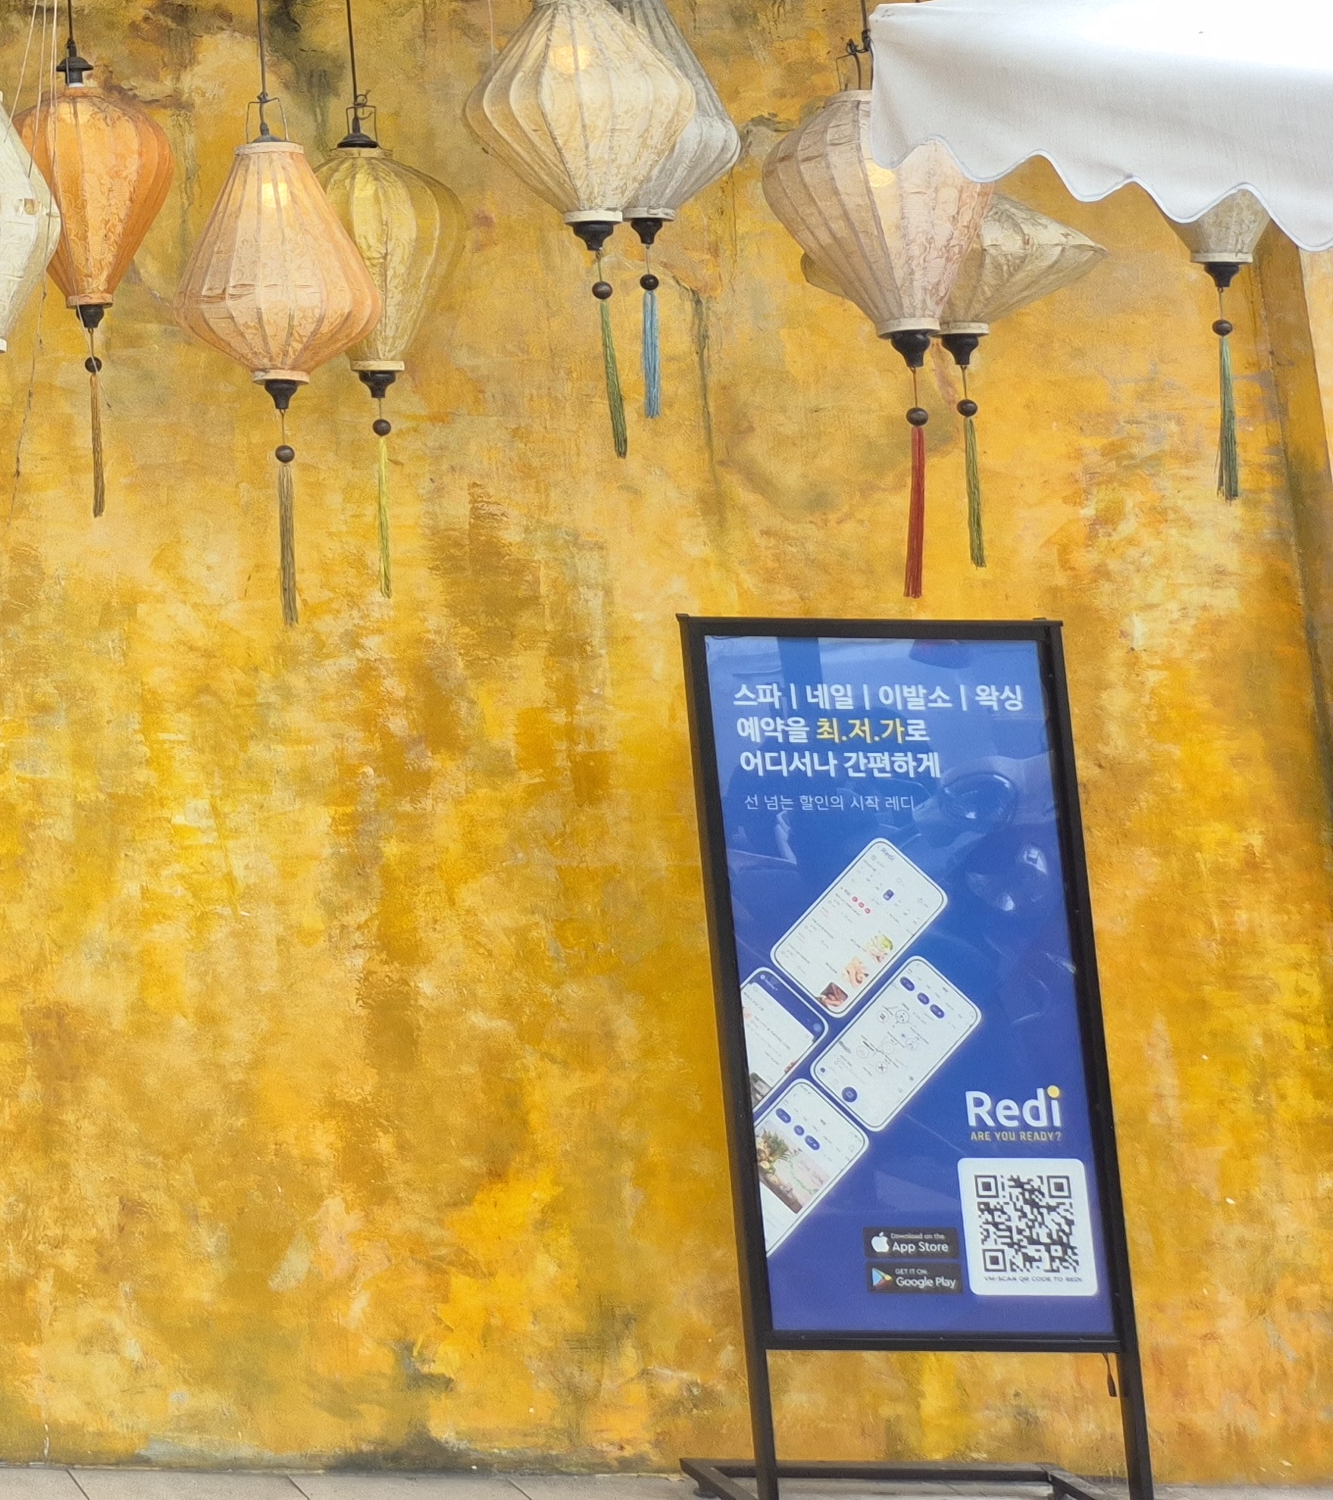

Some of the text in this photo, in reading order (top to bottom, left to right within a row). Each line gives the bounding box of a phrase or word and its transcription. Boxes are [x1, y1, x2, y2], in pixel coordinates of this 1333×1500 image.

[733, 684, 782, 706] 스파
[806, 684, 854, 710] 네일
[879, 684, 953, 710] 이발소
[974, 685, 1024, 712] 왁싱
[737, 717, 930, 744] 예약을 최.저.가로
[740, 750, 942, 778] 어디서나 간편하게
[744, 794, 915, 811] 선 넘는 할인의 시작 레디
[965, 1085, 1062, 1128] Redi
[971, 1131, 1062, 1142] ARE YOU READY?
[892, 1241, 949, 1255] App Store
[895, 1276, 956, 1289] Google Play
